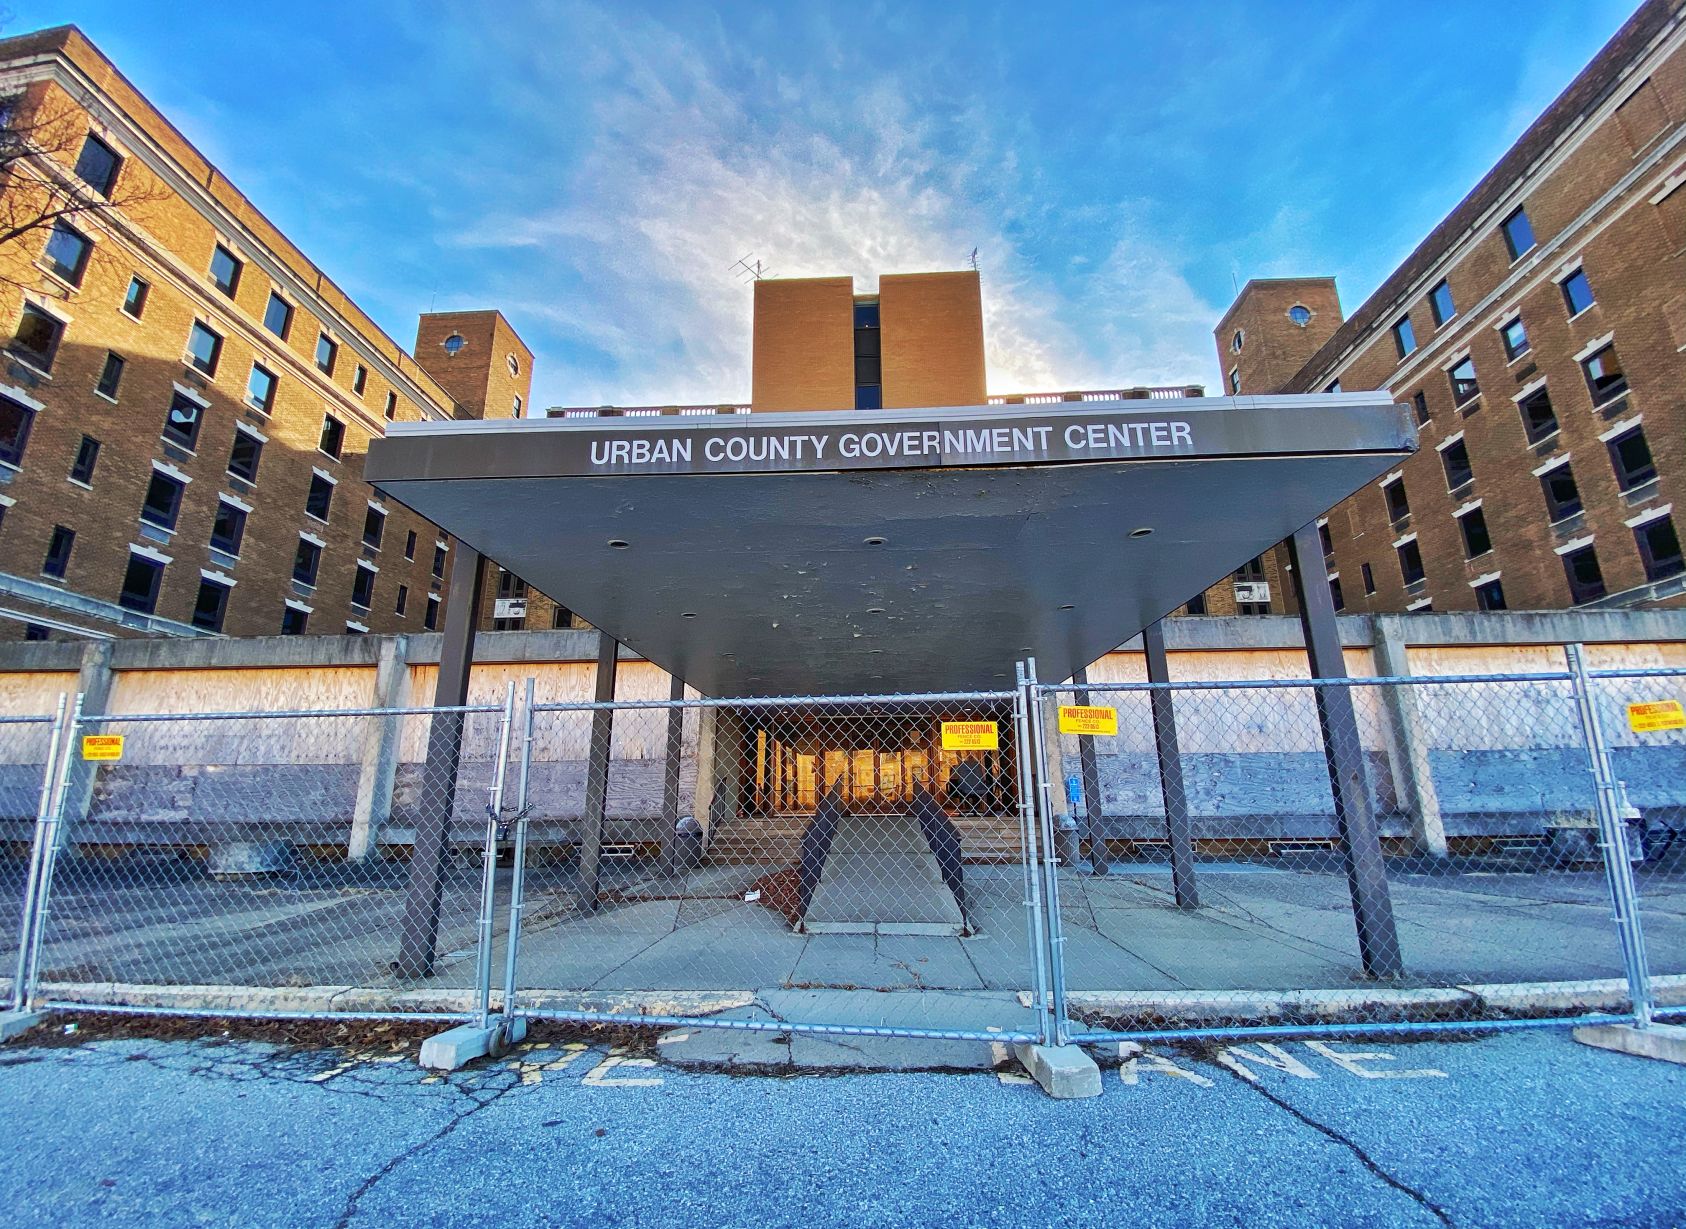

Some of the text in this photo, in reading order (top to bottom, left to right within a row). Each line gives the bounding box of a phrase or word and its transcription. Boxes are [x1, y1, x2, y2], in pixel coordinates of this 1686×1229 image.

[590, 421, 1193, 465] URBAN COUNTY GOVERNMENT CENTER
[1062, 708, 1113, 720] PROFESSIONAL
[944, 724, 994, 735] PROFESSIONAL
